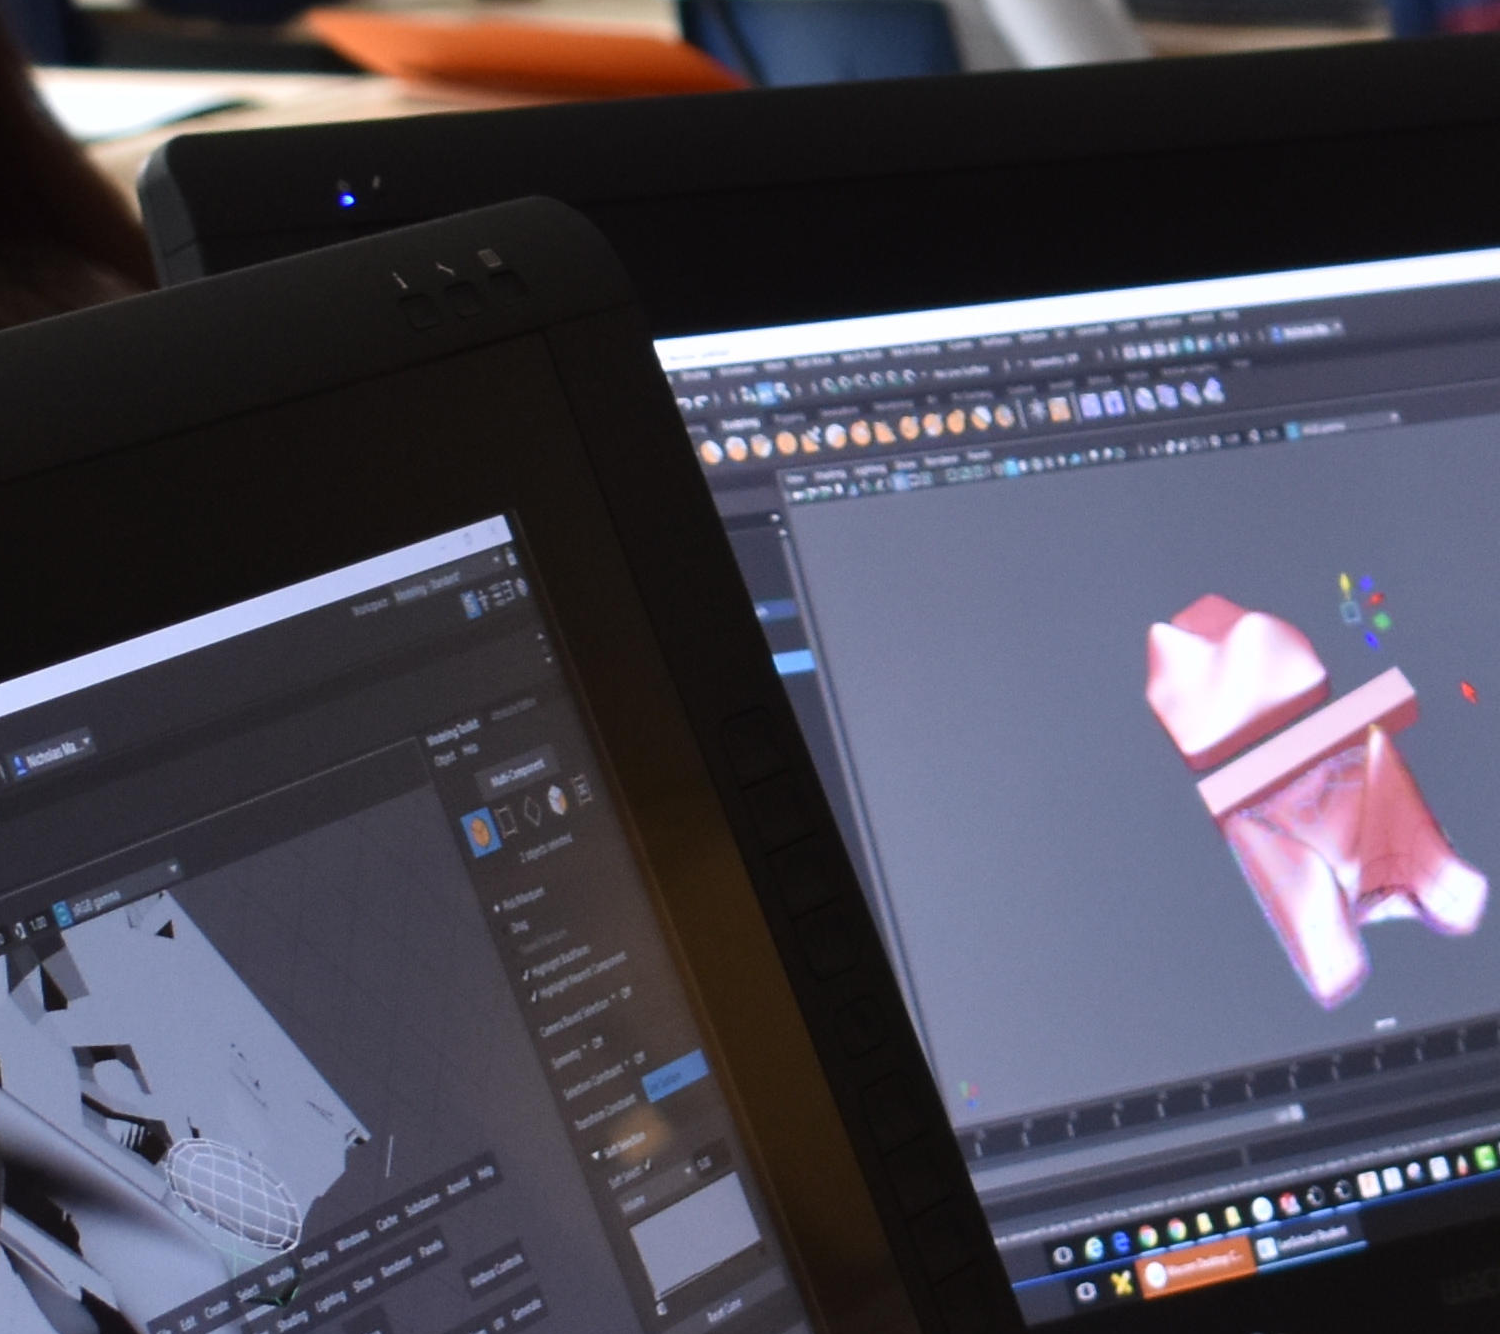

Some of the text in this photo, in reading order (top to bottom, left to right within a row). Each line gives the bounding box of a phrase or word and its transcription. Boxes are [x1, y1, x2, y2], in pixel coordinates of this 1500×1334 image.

[25, 744, 64, 769] Nicholas
[179, 1314, 197, 1331] Edit
[203, 1297, 231, 1319] Create
[236, 1282, 261, 1303] Select
[266, 1264, 297, 1290] Modify
[301, 1247, 331, 1272] Display
[335, 1226, 371, 1253] Windows
[375, 1212, 399, 1233] Cache
[404, 1191, 441, 1217] Substance
[276, 1308, 310, 1334] Shading
[314, 1288, 348, 1315] Lighting
[352, 1273, 375, 1294] Show
[418, 1238, 444, 1259] Panels
